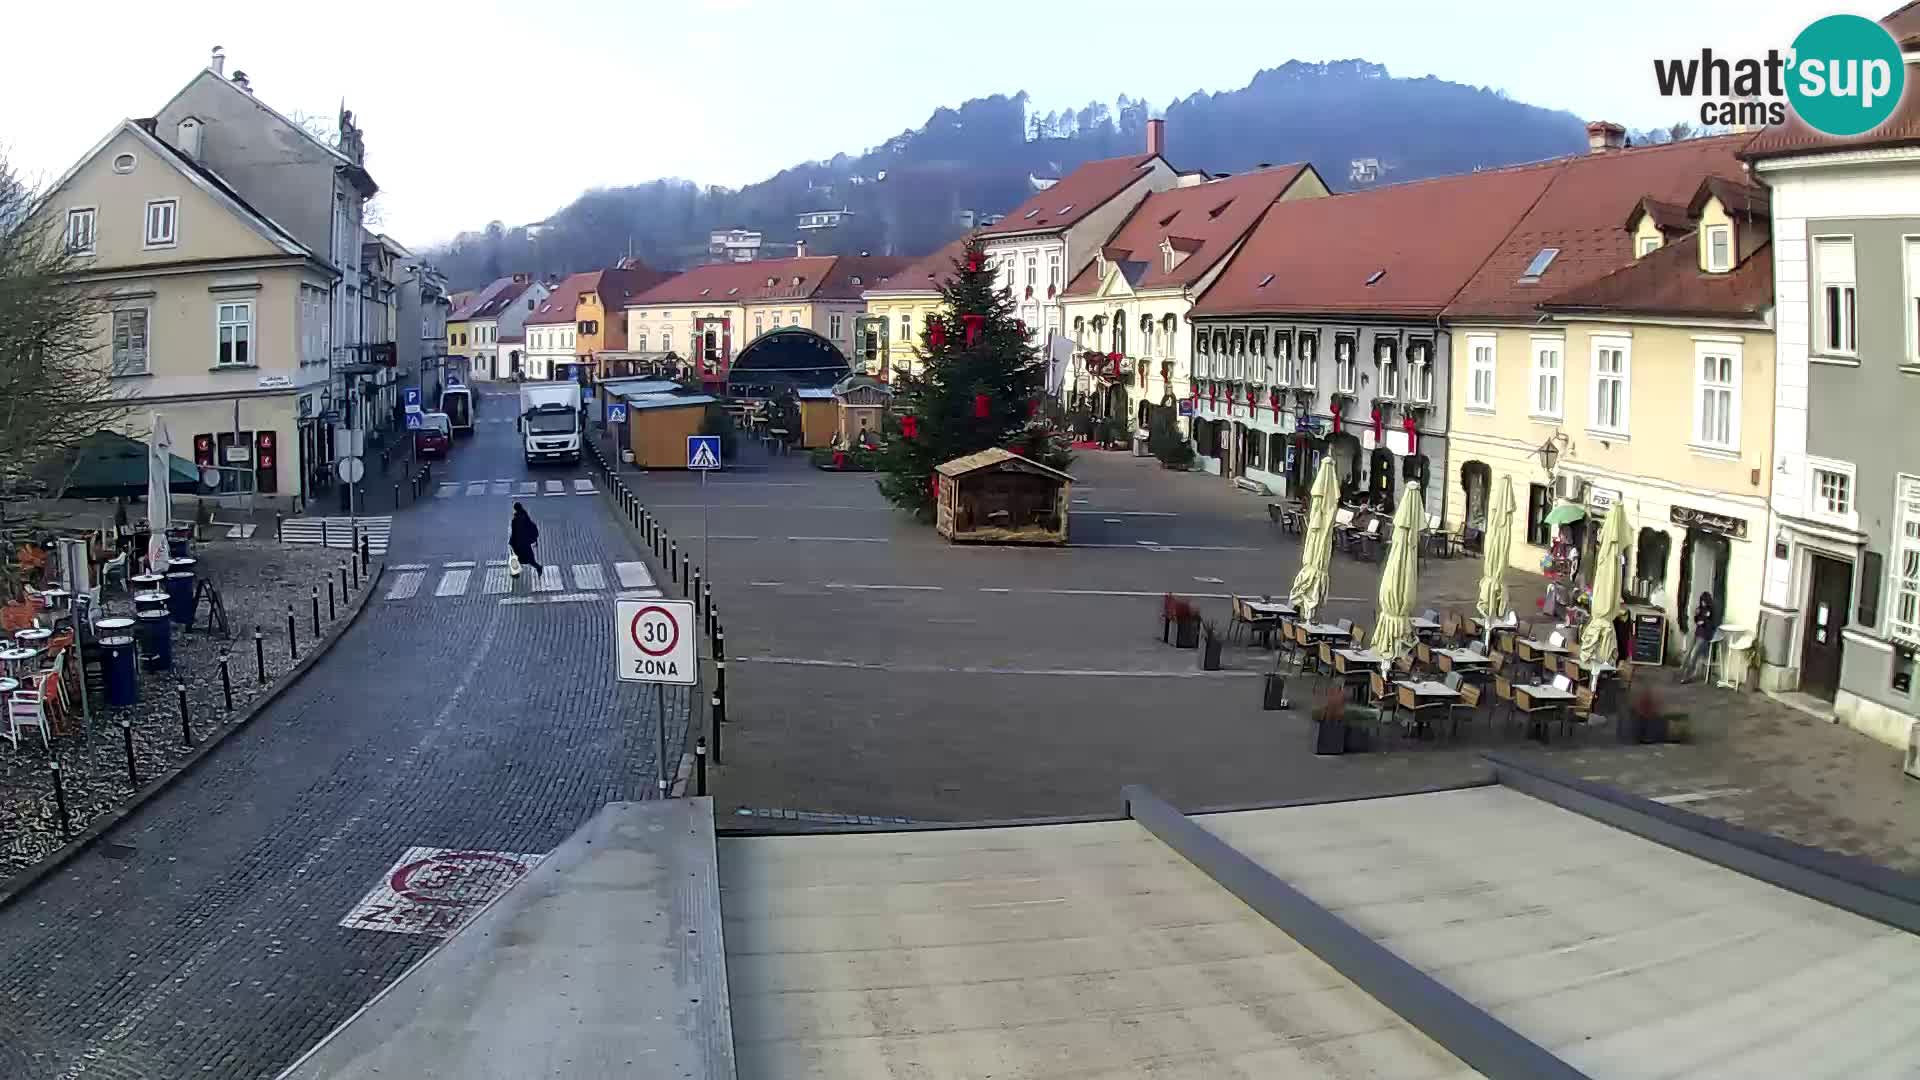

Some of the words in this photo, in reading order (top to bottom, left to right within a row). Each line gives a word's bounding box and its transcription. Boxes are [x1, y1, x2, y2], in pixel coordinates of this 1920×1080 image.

[409, 391, 417, 403] P
[644, 622, 668, 643] 30
[634, 659, 678, 676] ZONA
